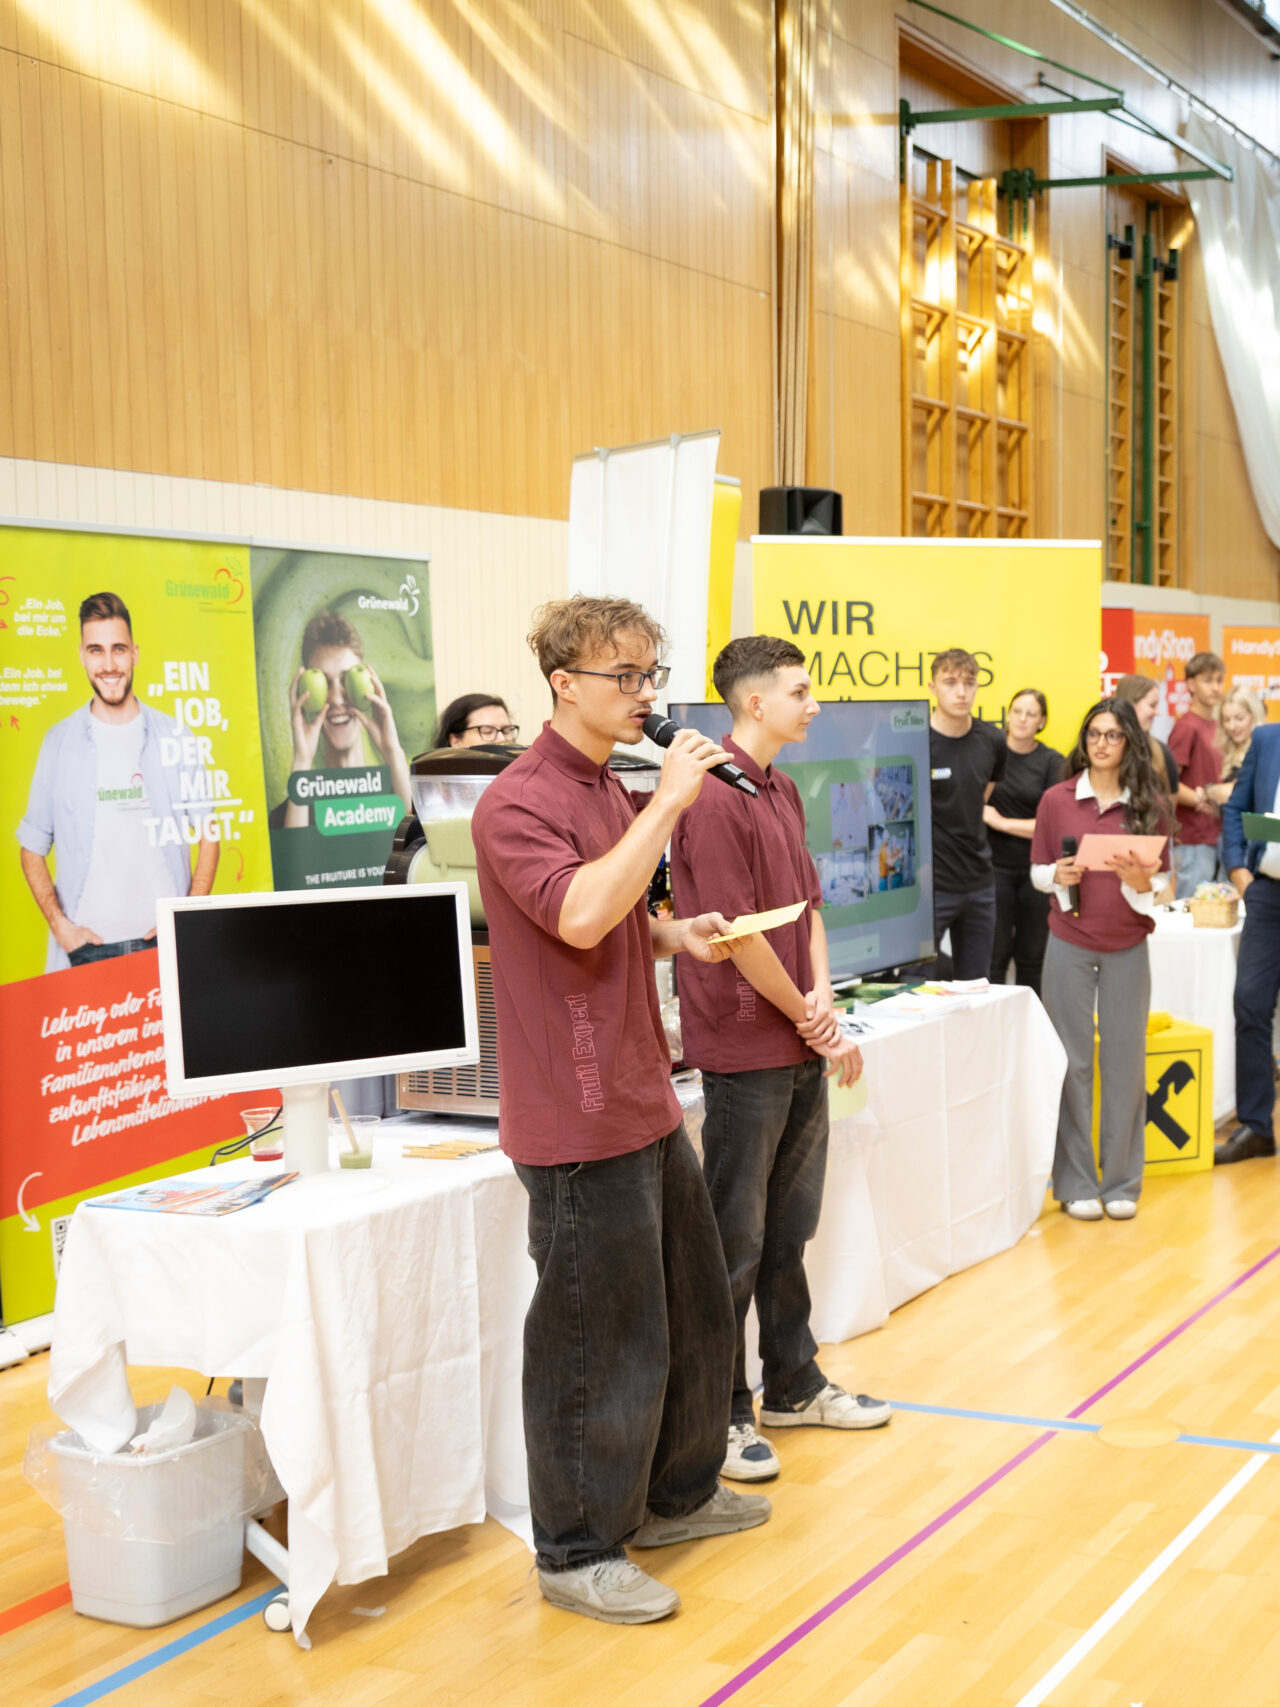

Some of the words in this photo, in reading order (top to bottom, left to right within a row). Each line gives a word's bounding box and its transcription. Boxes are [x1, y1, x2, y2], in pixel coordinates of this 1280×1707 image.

[165, 579, 230, 599] Grünewald
[357, 595, 409, 612] Grünewald
[13, 611, 31, 623] bei
[32, 612, 49, 623] mir
[51, 614, 66, 623] um
[17, 625, 34, 636] die
[782, 600, 875, 635] WIR
[1134, 629, 1196, 666] ndyShop
[22, 681, 40, 692] ich
[40, 682, 68, 692] etwas
[47, 667, 63, 678] bei
[172, 697, 229, 736] JOB,
[159, 735, 216, 767] DER
[179, 769, 232, 801] MIR
[296, 771, 382, 798] Grünewald
[324, 803, 396, 828] Academy
[305, 874, 320, 885] THE
[321, 868, 358, 883] FRUITURE
[358, 868, 366, 879] IS
[367, 865, 386, 877] YOU
[40, 1004, 108, 1038] Lehrling
[110, 992, 146, 1019] oder
[564, 993, 595, 1060] Expert
[55, 1040, 71, 1062] in
[76, 1026, 138, 1057] unserem
[142, 1017, 164, 1038] inn
[40, 1045, 166, 1096] Familienunterne
[49, 1073, 161, 1123] zukunftsfähige
[576, 1063, 605, 1113] Fruit
